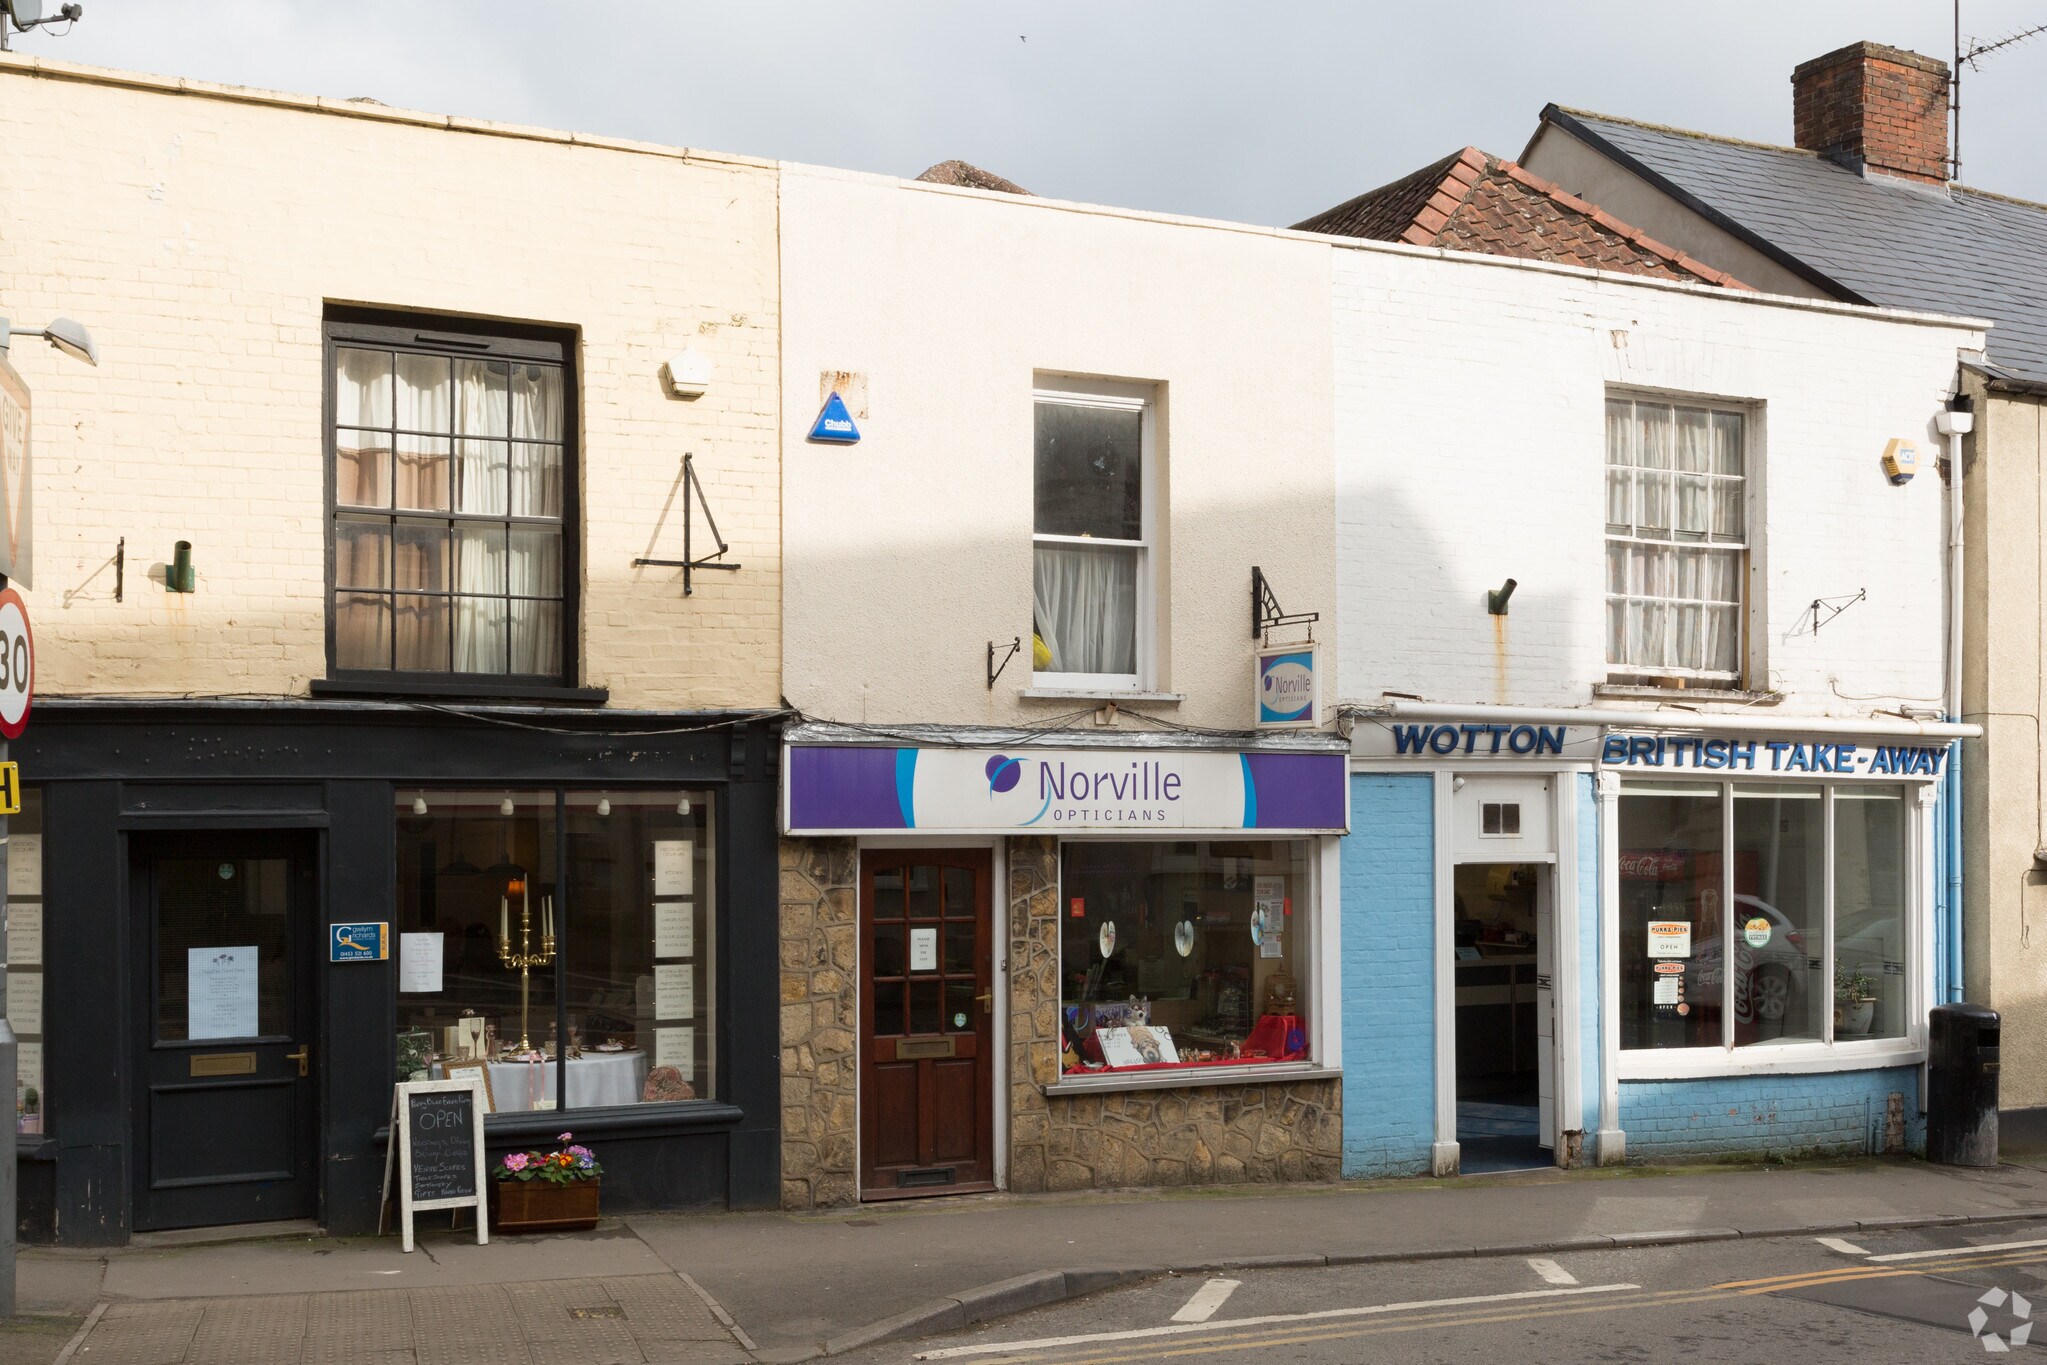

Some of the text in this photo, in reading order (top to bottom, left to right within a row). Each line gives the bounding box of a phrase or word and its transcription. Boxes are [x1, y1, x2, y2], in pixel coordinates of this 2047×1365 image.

[3, 394, 22, 446] GIVE
[824, 418, 852, 428] Chubb
[0, 629, 28, 694] 30
[1275, 674, 1311, 694] Norville
[1279, 695, 1307, 703] OPTICIANS
[1392, 724, 1948, 775] WOTTON BRITISH TAKE-AWAY
[1039, 761, 1182, 802] Norville
[1053, 809, 1166, 821] OPTICIANS
[419, 1107, 464, 1130] OPEN
